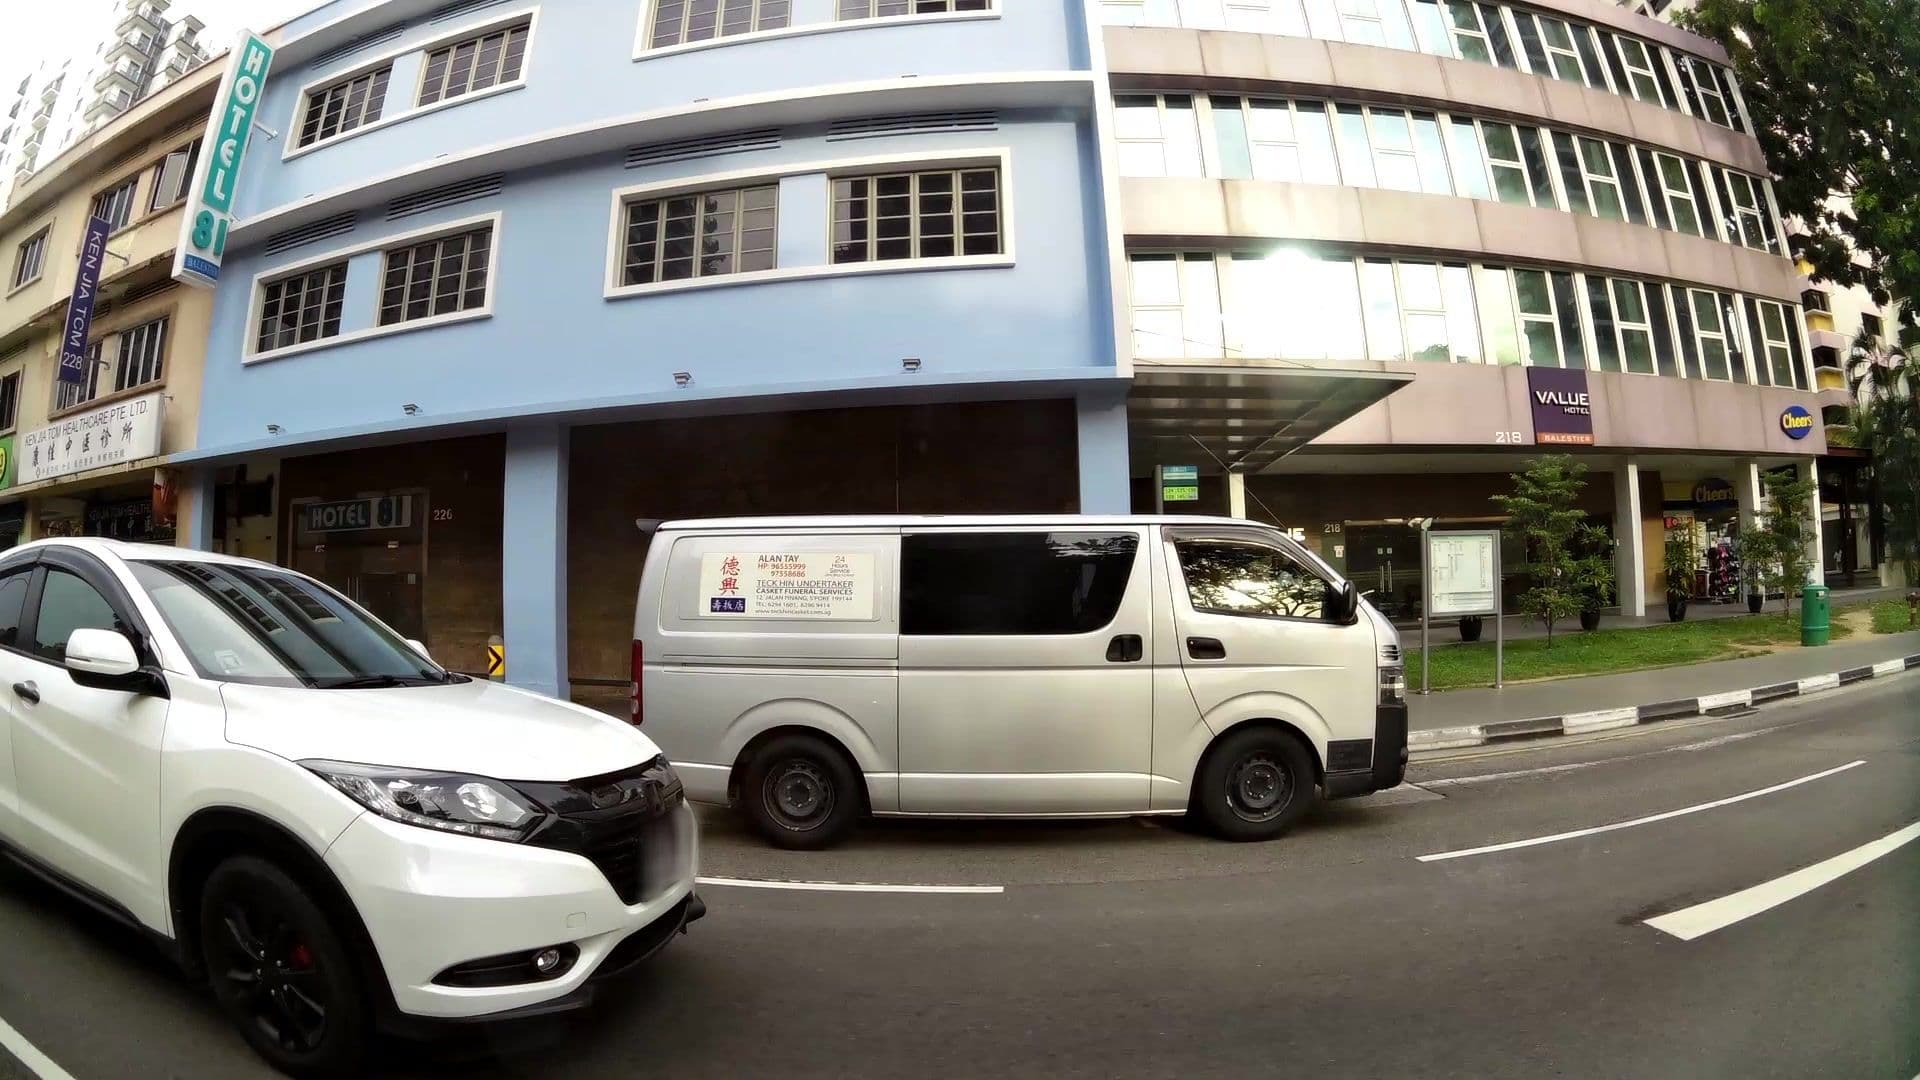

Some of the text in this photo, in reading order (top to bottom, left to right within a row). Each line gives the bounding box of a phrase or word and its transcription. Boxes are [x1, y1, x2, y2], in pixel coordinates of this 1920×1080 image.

[192, 45, 266, 257] HOTEL 81
[69, 230, 104, 348] KEN JIA TCM
[62, 351, 83, 370] 228
[1535, 390, 1589, 406] VALUE
[1563, 407, 1590, 415] HOTEL
[1782, 412, 1814, 429] Cheers
[25, 435, 37, 447] KEN
[62, 411, 109, 435] HEALTHCARE
[1495, 431, 1522, 443] 218
[1695, 484, 1735, 503] Cheers
[311, 504, 366, 528] HOTEL
[433, 508, 454, 521] 226
[1324, 523, 1341, 533] 218
[756, 587, 854, 596] CASKET FUNERAL SERVICES
[757, 579, 854, 589] TECK HIN UNDERTAKER
